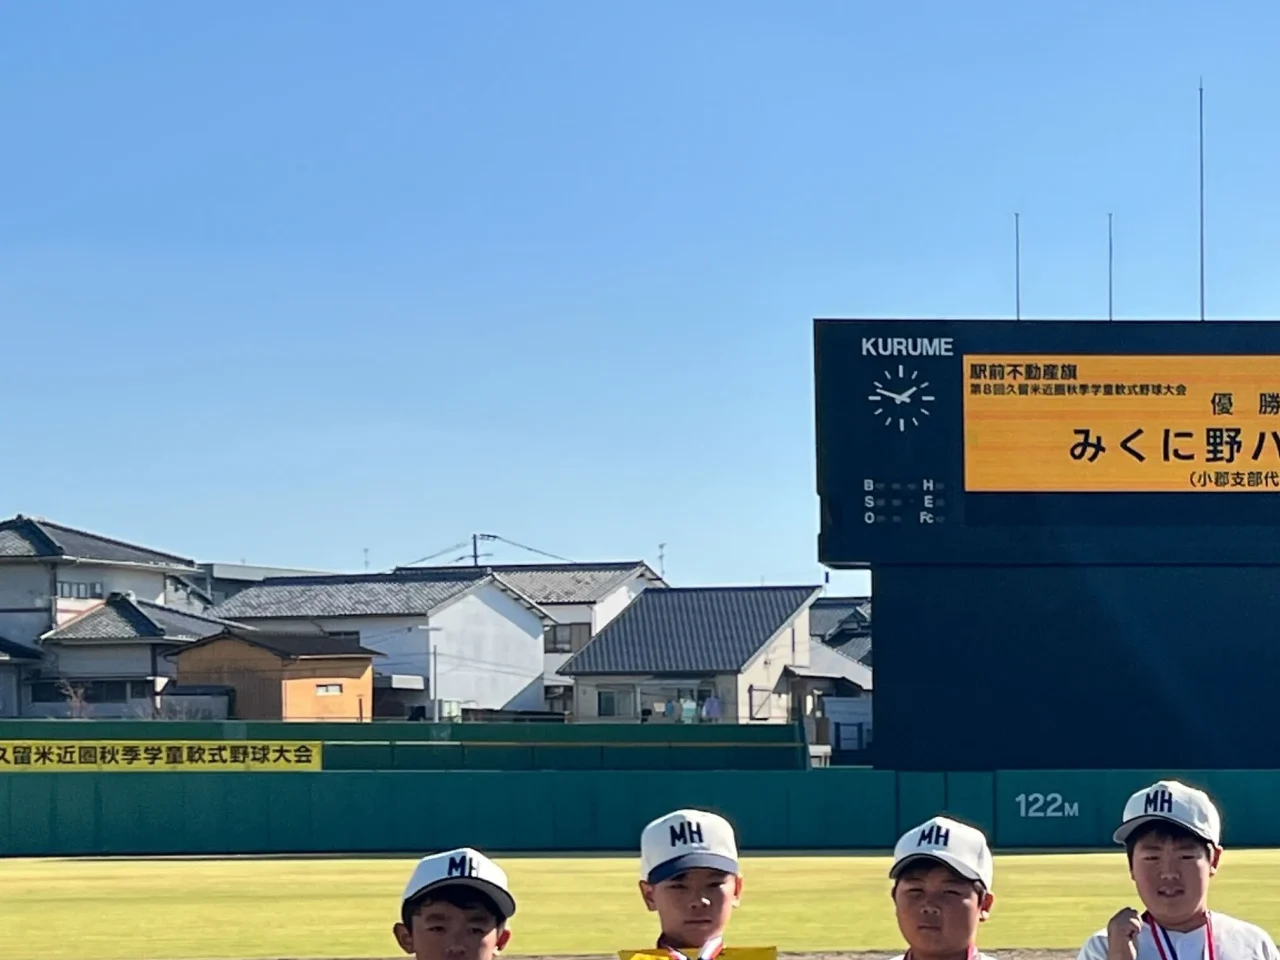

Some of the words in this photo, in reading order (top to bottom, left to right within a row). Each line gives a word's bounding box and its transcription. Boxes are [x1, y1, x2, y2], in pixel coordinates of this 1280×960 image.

[862, 338, 953, 356] KURUME
[970, 363, 1078, 380] 駅前不動産旗
[1210, 392, 1280, 416] 優勝
[864, 480, 874, 491] B
[923, 480, 934, 491] H
[864, 496, 874, 507] S
[924, 496, 933, 507] E
[1144, 789, 1173, 814] MH
[669, 820, 704, 847] MH
[917, 825, 949, 847] MH
